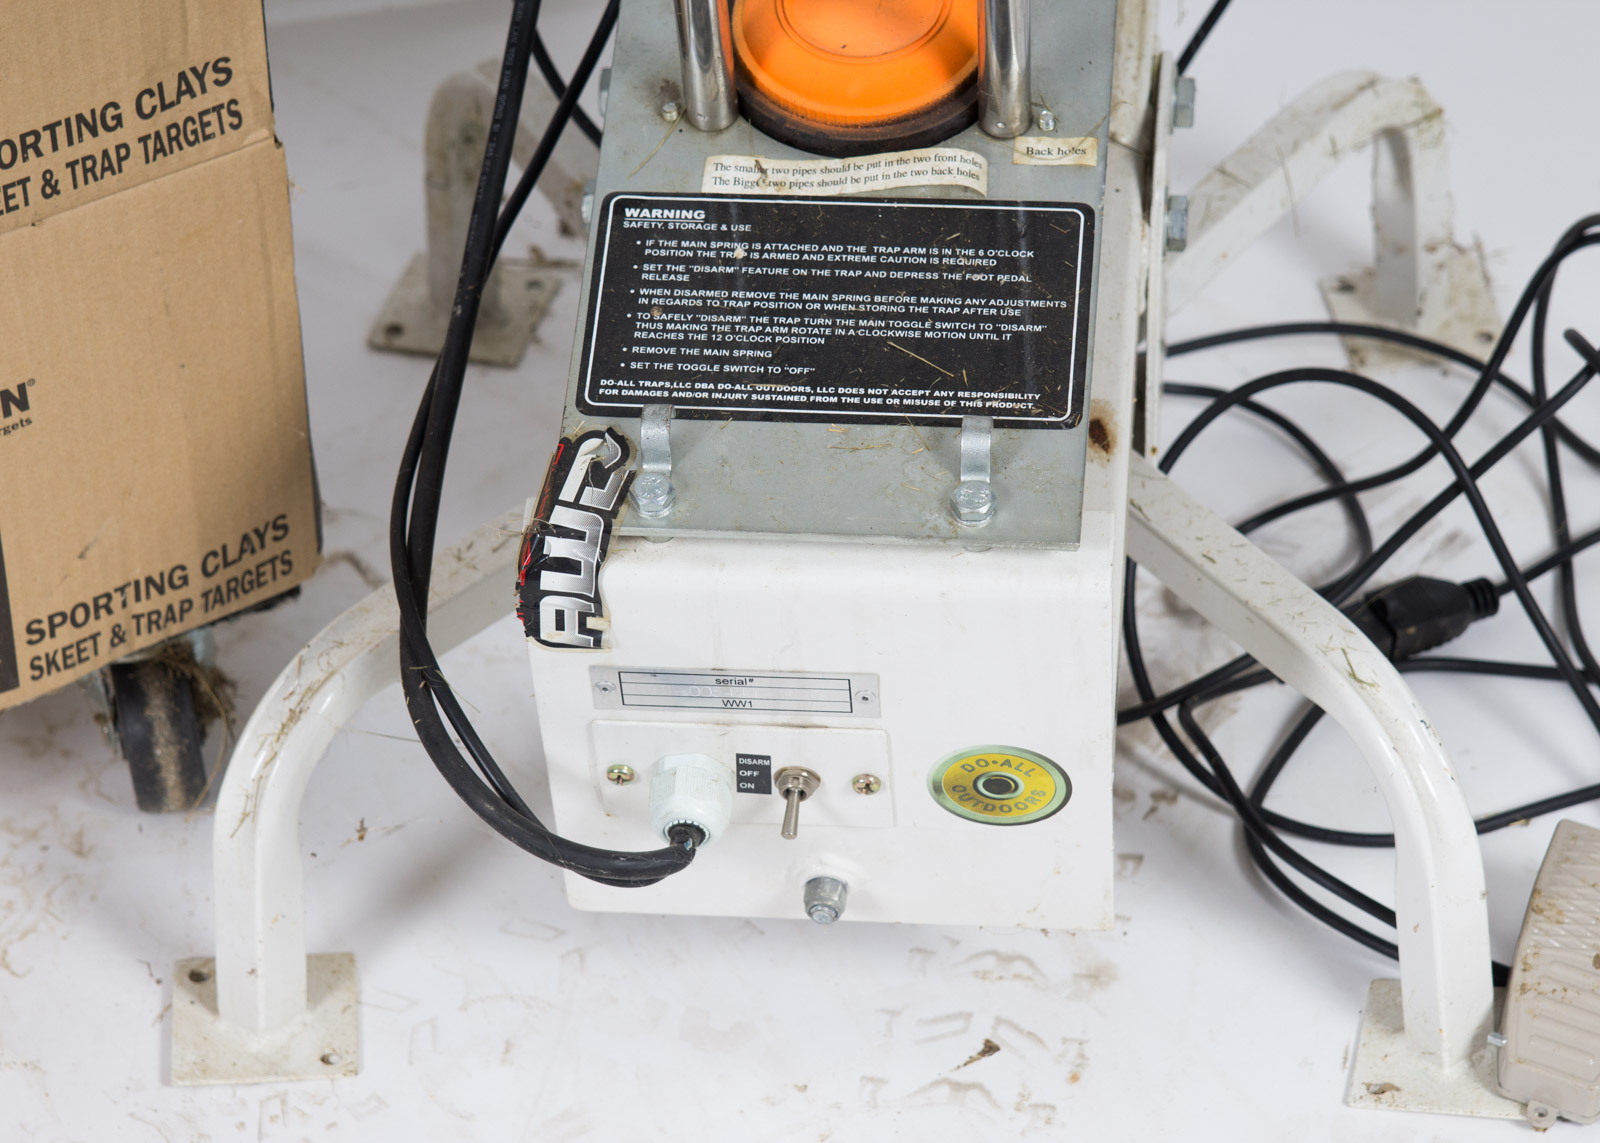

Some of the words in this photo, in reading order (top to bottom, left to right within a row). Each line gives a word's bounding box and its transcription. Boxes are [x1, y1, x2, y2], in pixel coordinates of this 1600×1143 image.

[0, 101, 124, 170] ORTING
[135, 56, 233, 121] CLAYS
[0, 176, 31, 216] ET
[41, 169, 61, 199] &
[65, 142, 131, 190] TRAP
[138, 98, 243, 165] TARGETS
[1026, 146, 1053, 156] Back
[1057, 146, 1087, 156] holes
[714, 162, 732, 172] The
[772, 166, 790, 174] two
[792, 165, 817, 176] pipes
[820, 164, 850, 174] should
[853, 163, 864, 172] be
[866, 161, 882, 171] put
[896, 157, 910, 166] the
[913, 155, 932, 164] two
[934, 153, 957, 162] front
[960, 154, 983, 170] holes
[712, 177, 730, 186] The
[768, 179, 787, 188] two
[789, 178, 814, 190] pipes
[816, 177, 848, 188] should
[850, 176, 862, 184] be
[864, 174, 878, 184] put
[893, 170, 908, 179] the
[910, 168, 928, 177] two
[931, 167, 954, 176] back
[956, 168, 980, 180] holes
[625, 208, 705, 219] WARNING
[667, 222, 717, 231] STORAGE
[730, 224, 751, 232] USE
[644, 249, 693, 258] POSITION
[696, 250, 716, 258] THE
[761, 252, 799, 261] ARMED
[802, 253, 824, 261] AND
[827, 254, 876, 263] EXTREME
[880, 255, 926, 264] CAUTION
[942, 257, 996, 266] REQUIRED
[658, 240, 677, 248] THE
[681, 240, 706, 249] MAIN
[710, 241, 748, 250] SPRING
[763, 243, 818, 252] ATTACHED
[821, 244, 843, 252] AND
[846, 245, 866, 253] THE
[873, 246, 900, 254] TRAP
[902, 247, 926, 255] ARM
[955, 248, 975, 256] THE
[987, 249, 1033, 258] O'CLOCK
[641, 273, 689, 282] RELEASE
[642, 264, 662, 272] SET
[666, 264, 685, 272] THE
[689, 265, 739, 274] "DISARM"
[741, 266, 789, 275] FEATURE
[811, 269, 830, 277] THE
[834, 269, 862, 278] TRAP
[864, 270, 886, 278] AND
[889, 271, 938, 280] DEPRESS
[942, 272, 962, 281] THE
[965, 273, 994, 282] FOOT
[997, 274, 1031, 283] PEDAL
[639, 288, 671, 297] WHEN
[673, 289, 728, 298] DISARMED
[731, 291, 775, 300] REMOVE
[779, 292, 799, 300] THE
[802, 293, 828, 301] MAIN
[831, 293, 871, 302] SPRING
[874, 295, 916, 304] BEFORE
[920, 296, 961, 305] MAKING
[964, 297, 986, 306] ANY
[988, 298, 1066, 308] ADJUSTMENTS
[651, 297, 702, 307] REGARDS
[723, 300, 750, 308] TRAP
[753, 300, 802, 310] POSITION
[824, 302, 854, 311] WHEN
[858, 304, 905, 313] STORING
[908, 305, 928, 314] THE
[932, 306, 960, 315] TRAP
[962, 307, 997, 316] AFTER
[1000, 308, 1021, 316] USE
[635, 322, 662, 330] THUS
[666, 323, 707, 332] MAKING
[711, 324, 731, 332] THE
[734, 325, 762, 333] TRAP
[764, 326, 788, 334] ARM
[791, 326, 831, 335] ROTATE
[858, 329, 921, 338] CLOCKWISE
[924, 331, 965, 339] MOTION
[969, 332, 999, 340] UNTIL
[696, 314, 746, 323] "DISARM"
[749, 315, 769, 324] THE
[773, 316, 800, 325] TRAP
[804, 317, 832, 326] TURN
[835, 318, 855, 326] THE
[858, 319, 885, 327] MAIN
[886, 320, 932, 328] TOGGLE
[934, 321, 975, 330] SWITCH
[996, 323, 1047, 332] "DISARM"
[634, 331, 684, 341] REACHES
[687, 333, 707, 341] THE
[725, 334, 772, 343] O'CLOCK
[775, 335, 824, 345] POSITION
[632, 346, 676, 355] REMOVE
[680, 347, 700, 356] THE
[703, 348, 729, 357] MAIN
[732, 349, 772, 358] SPRING
[630, 361, 650, 370] SET
[653, 362, 673, 370] THE
[677, 363, 720, 372] TOGGLE
[723, 364, 764, 373] SWITCH
[784, 366, 815, 374] "OFF"
[598, 388, 618, 396] FOR
[621, 389, 668, 398] DAMAGES
[671, 391, 708, 399] AND/OR
[711, 392, 748, 400] INJURY
[751, 393, 807, 402] SUSTAINED
[809, 395, 837, 403] FROM
[840, 396, 860, 404] THE
[902, 398, 940, 406] MISUSE
[959, 400, 982, 408] THIS
[638, 380, 691, 390] TRAPS,LLC
[694, 382, 714, 390] DBA
[717, 383, 752, 392] DO-ALL
[755, 384, 813, 394] OUTDOORS,
[816, 386, 835, 394] LLC
[838, 386, 864, 395] DOES
[867, 387, 888, 396] NOT
[890, 388, 931, 397] ACCEPT
[933, 389, 954, 398] ANY
[957, 390, 1040, 401] RESPONSIBILITY
[25, 564, 189, 646] SPORTING
[201, 514, 290, 578] CLAYS
[29, 633, 102, 681] SKEET
[110, 623, 126, 648] &
[131, 598, 194, 637] TRAP
[200, 550, 293, 614] TARGETS
[714, 677, 754, 686] serial#
[722, 699, 754, 708] WW1
[738, 758, 770, 766] DISARM
[951, 784, 1046, 813] OUTDOORS
